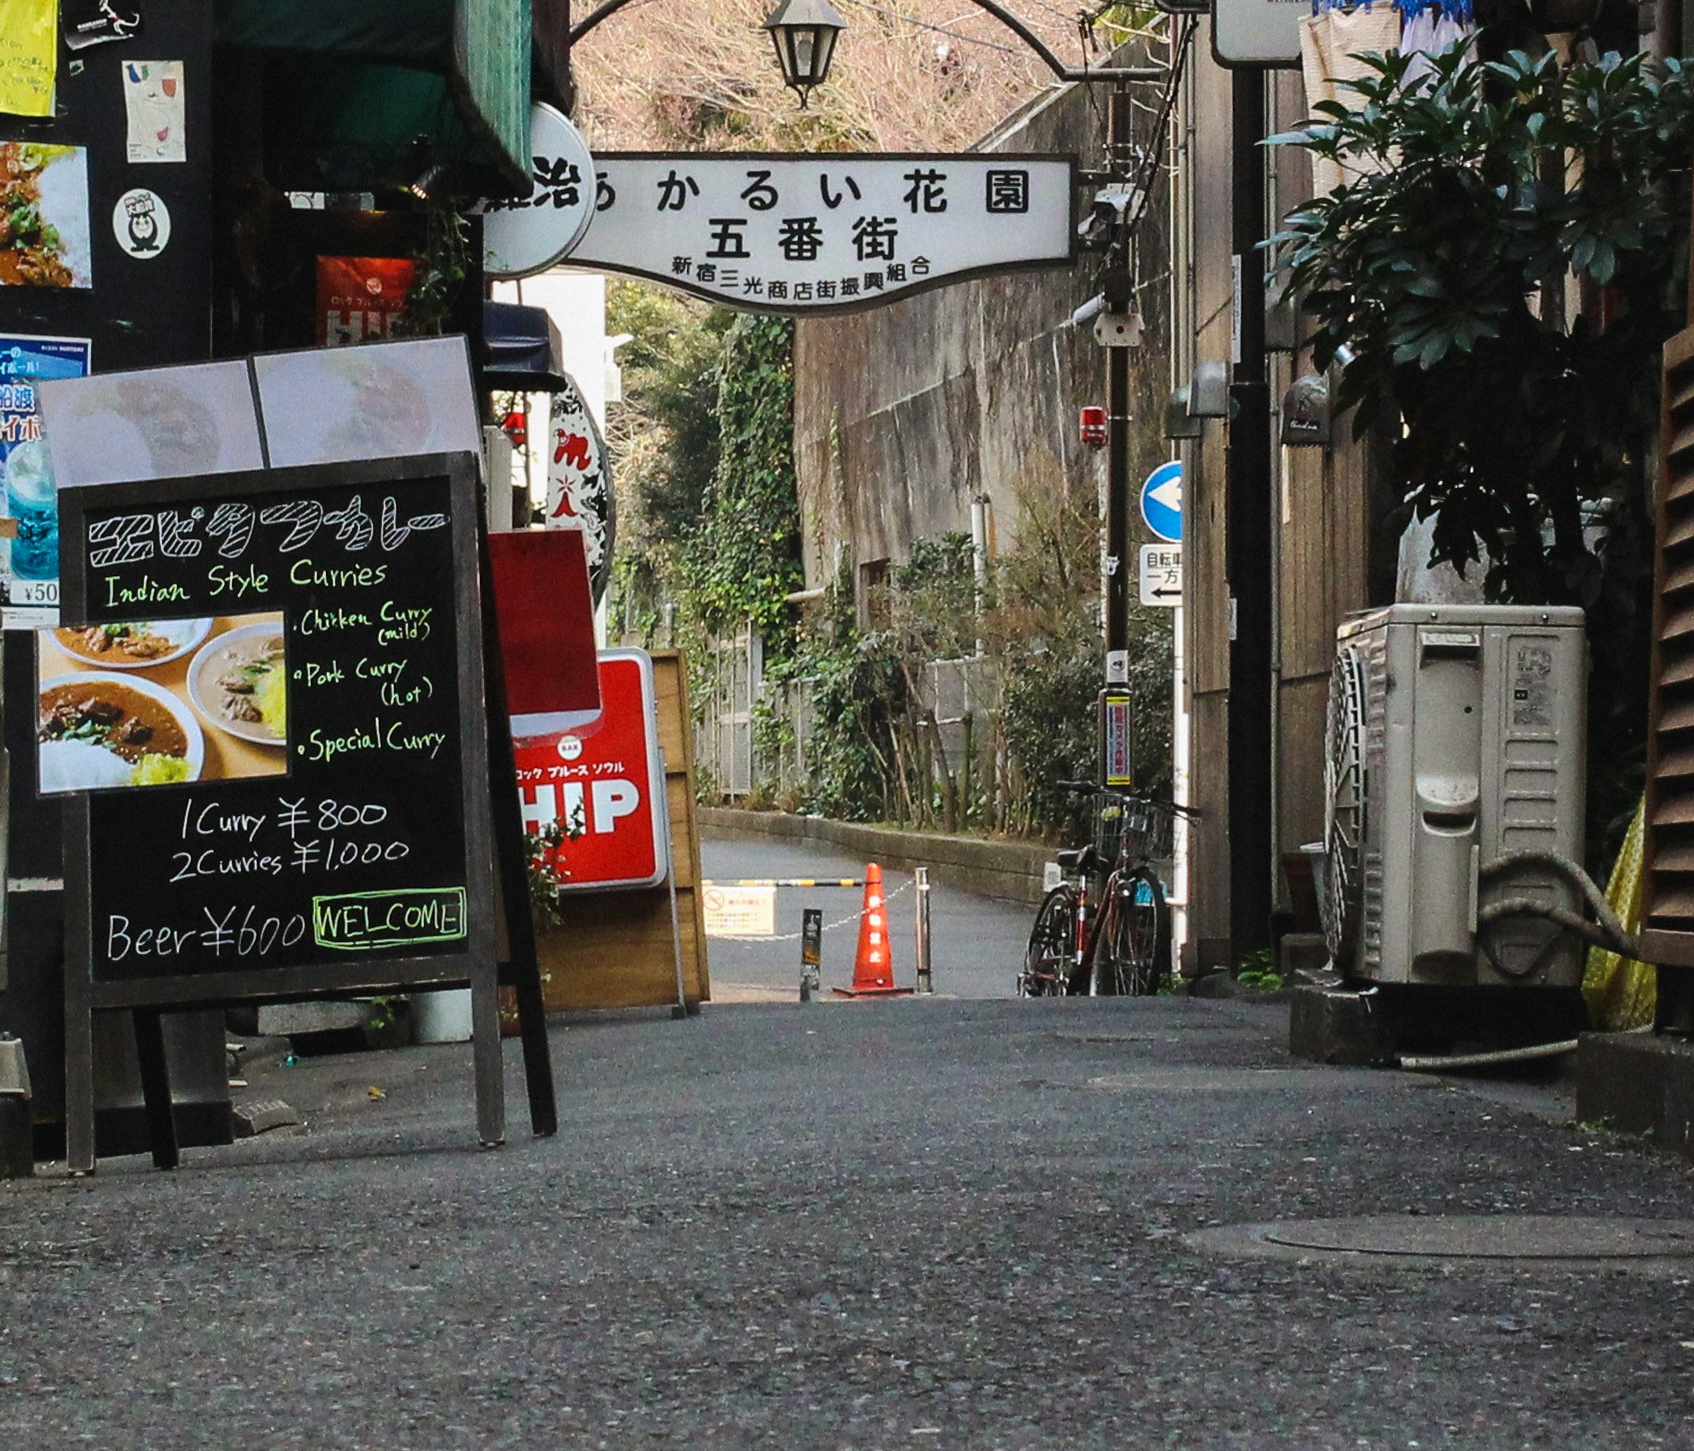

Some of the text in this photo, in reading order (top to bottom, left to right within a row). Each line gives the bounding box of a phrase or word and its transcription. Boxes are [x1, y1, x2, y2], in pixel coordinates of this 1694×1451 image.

[483, 157, 581, 213] 治
[706, 216, 898, 261] 五番街
[672, 255, 931, 301] 新宿三光商店街振興組合
[89, 495, 450, 567] エピタフカレー
[106, 559, 388, 607] Indian Style Curries
[301, 601, 432, 635] Chicken Curry
[378, 622, 431, 646] (mild)
[307, 658, 408, 687] Pork Curry
[381, 676, 433, 706] (hot)
[309, 717, 446, 763] Special Curry
[547, 764, 589, 779] ブルース
[592, 761, 626, 775] ソウル
[518, 779, 640, 838] HIP
[107, 914, 196, 960] Beer
[317, 899, 458, 938] WELCOME
